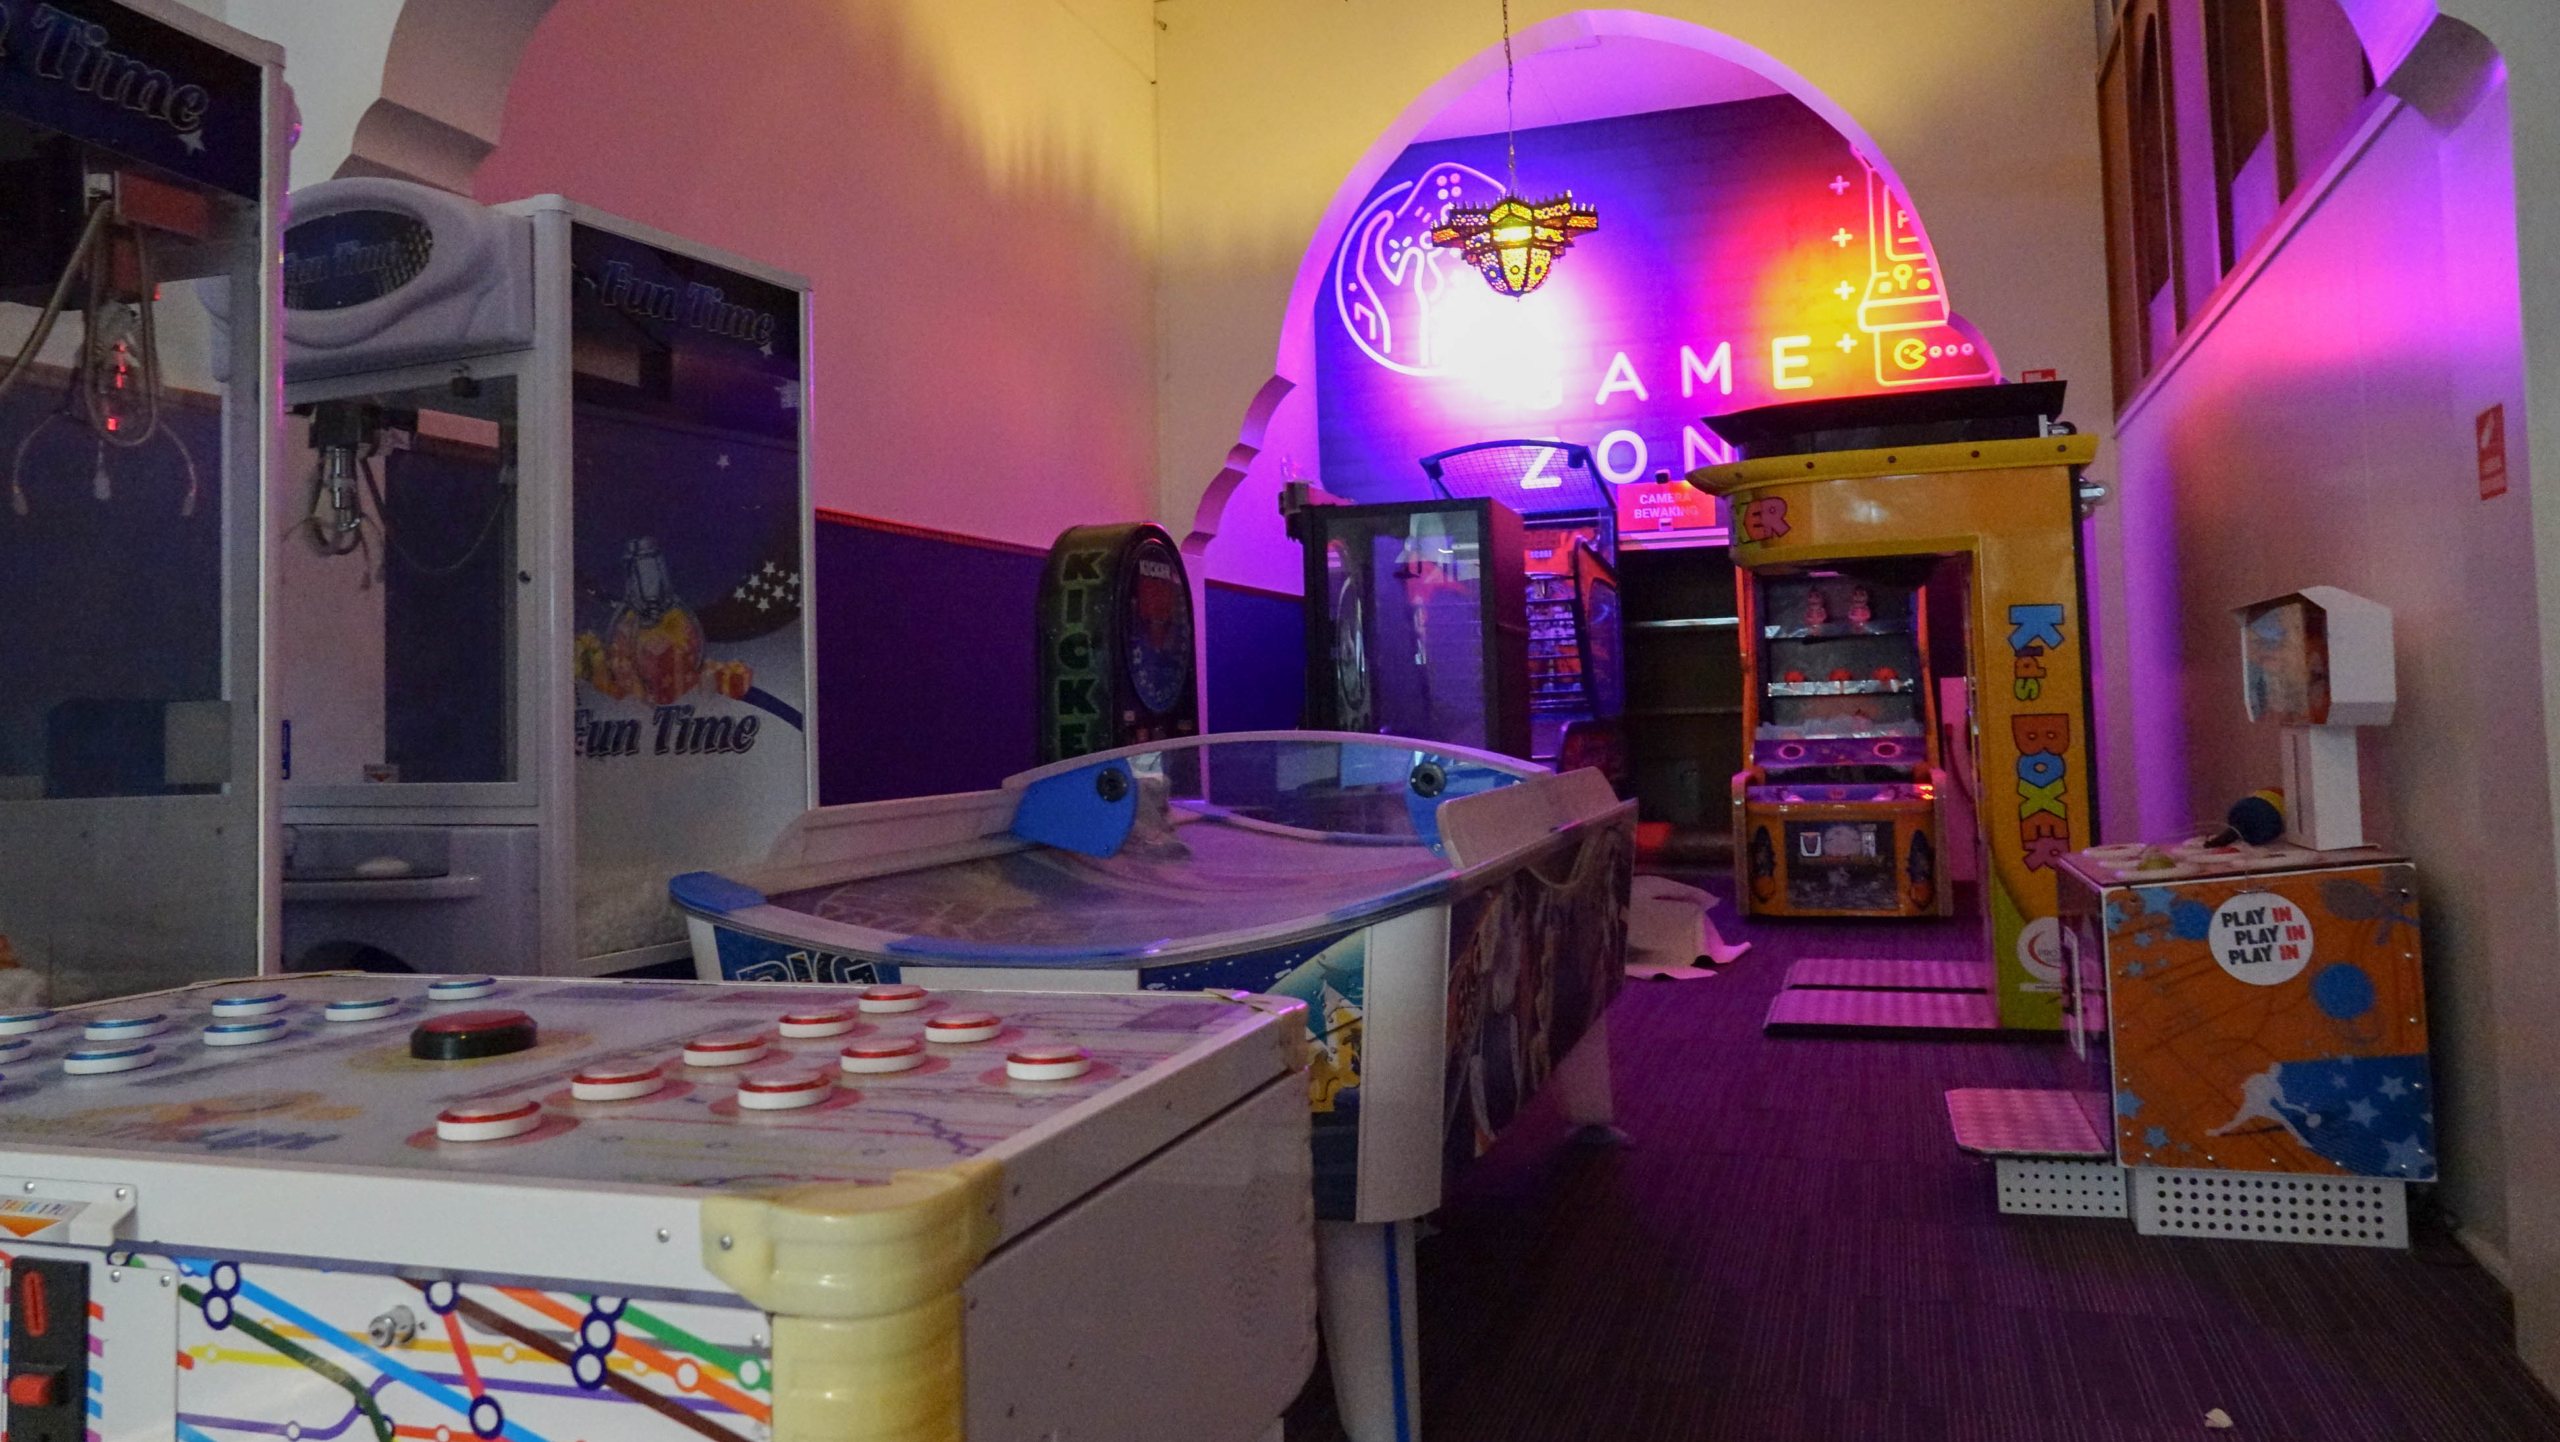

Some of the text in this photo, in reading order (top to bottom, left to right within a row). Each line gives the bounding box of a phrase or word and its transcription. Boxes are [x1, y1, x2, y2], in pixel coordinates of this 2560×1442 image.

[31, 3, 209, 131] Time
[602, 260, 774, 345] Fun Time
[1512, 335, 1814, 410] AME
[1520, 425, 1734, 490] ZON
[1633, 506, 1699, 519] BEWAKING
[1639, 492, 1692, 505] CAMERA
[1057, 550, 1106, 757] KICKE
[653, 704, 760, 756] Time
[2011, 713, 2071, 873] BOXER
[2221, 906, 2293, 928] PLAY IN
[2234, 924, 2306, 946] PLAY IN
[2228, 944, 2300, 965] PLAY IN
